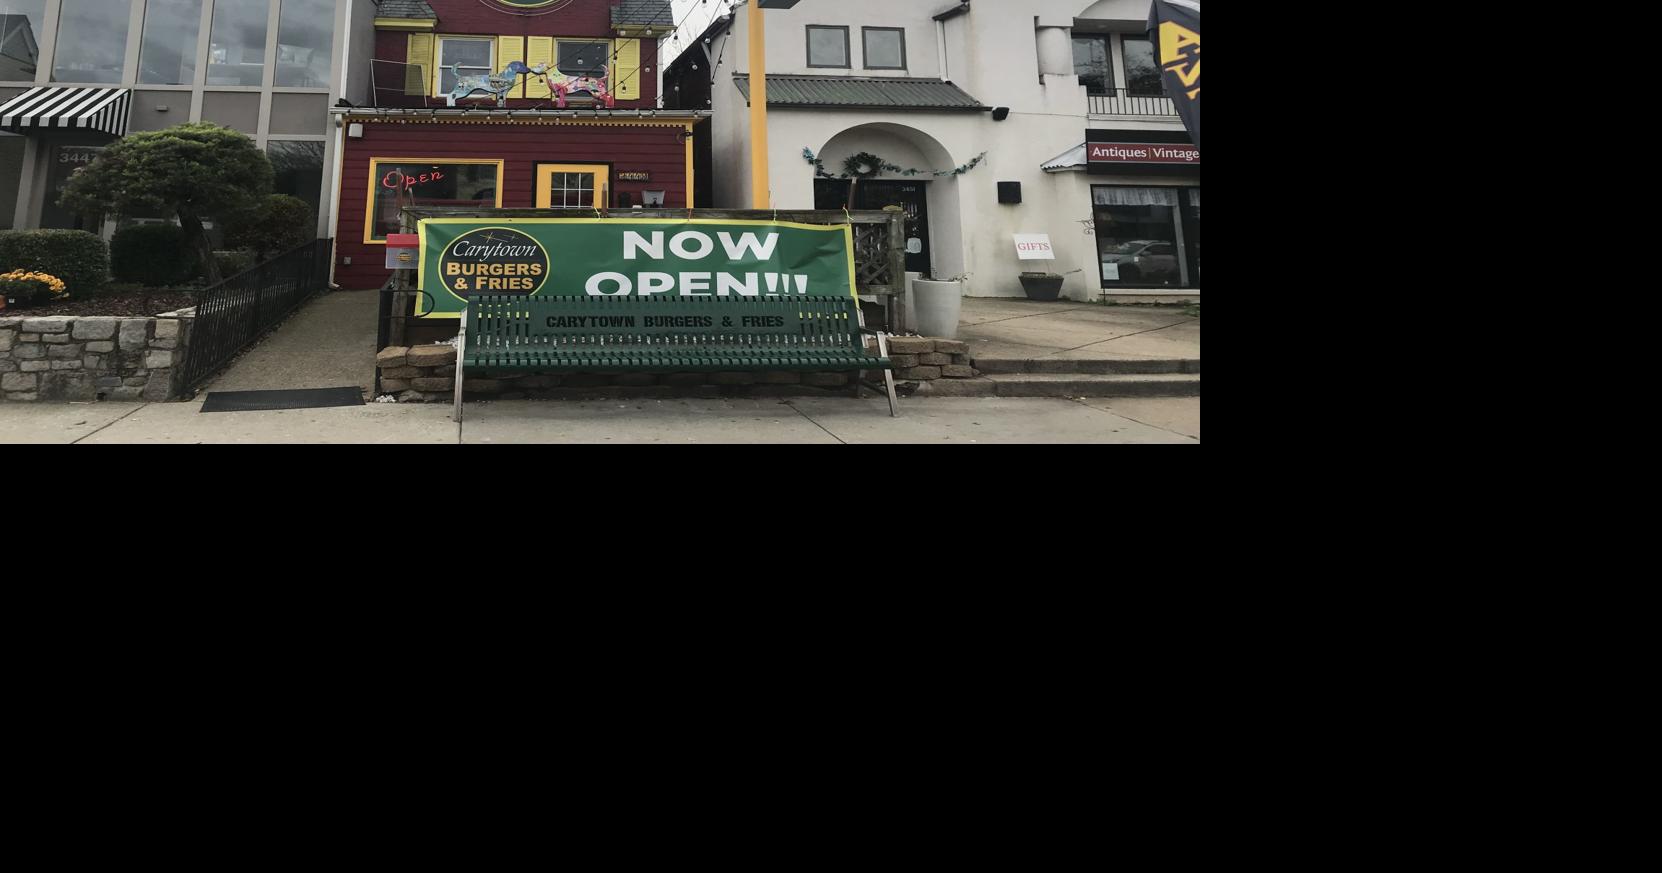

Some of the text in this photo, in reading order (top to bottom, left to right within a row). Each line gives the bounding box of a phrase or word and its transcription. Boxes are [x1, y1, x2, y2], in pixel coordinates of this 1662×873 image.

[1092, 146, 1200, 161] Antiques Vintage
[383, 170, 445, 191] Open
[452, 240, 537, 262] Carytown
[623, 230, 779, 260] NOW
[1017, 242, 1050, 251] GIFTS
[446, 262, 542, 276] BURGERS
[454, 276, 534, 290] & FRIES
[546, 315, 785, 328] CARYTOWN BURGERS & FRIES
